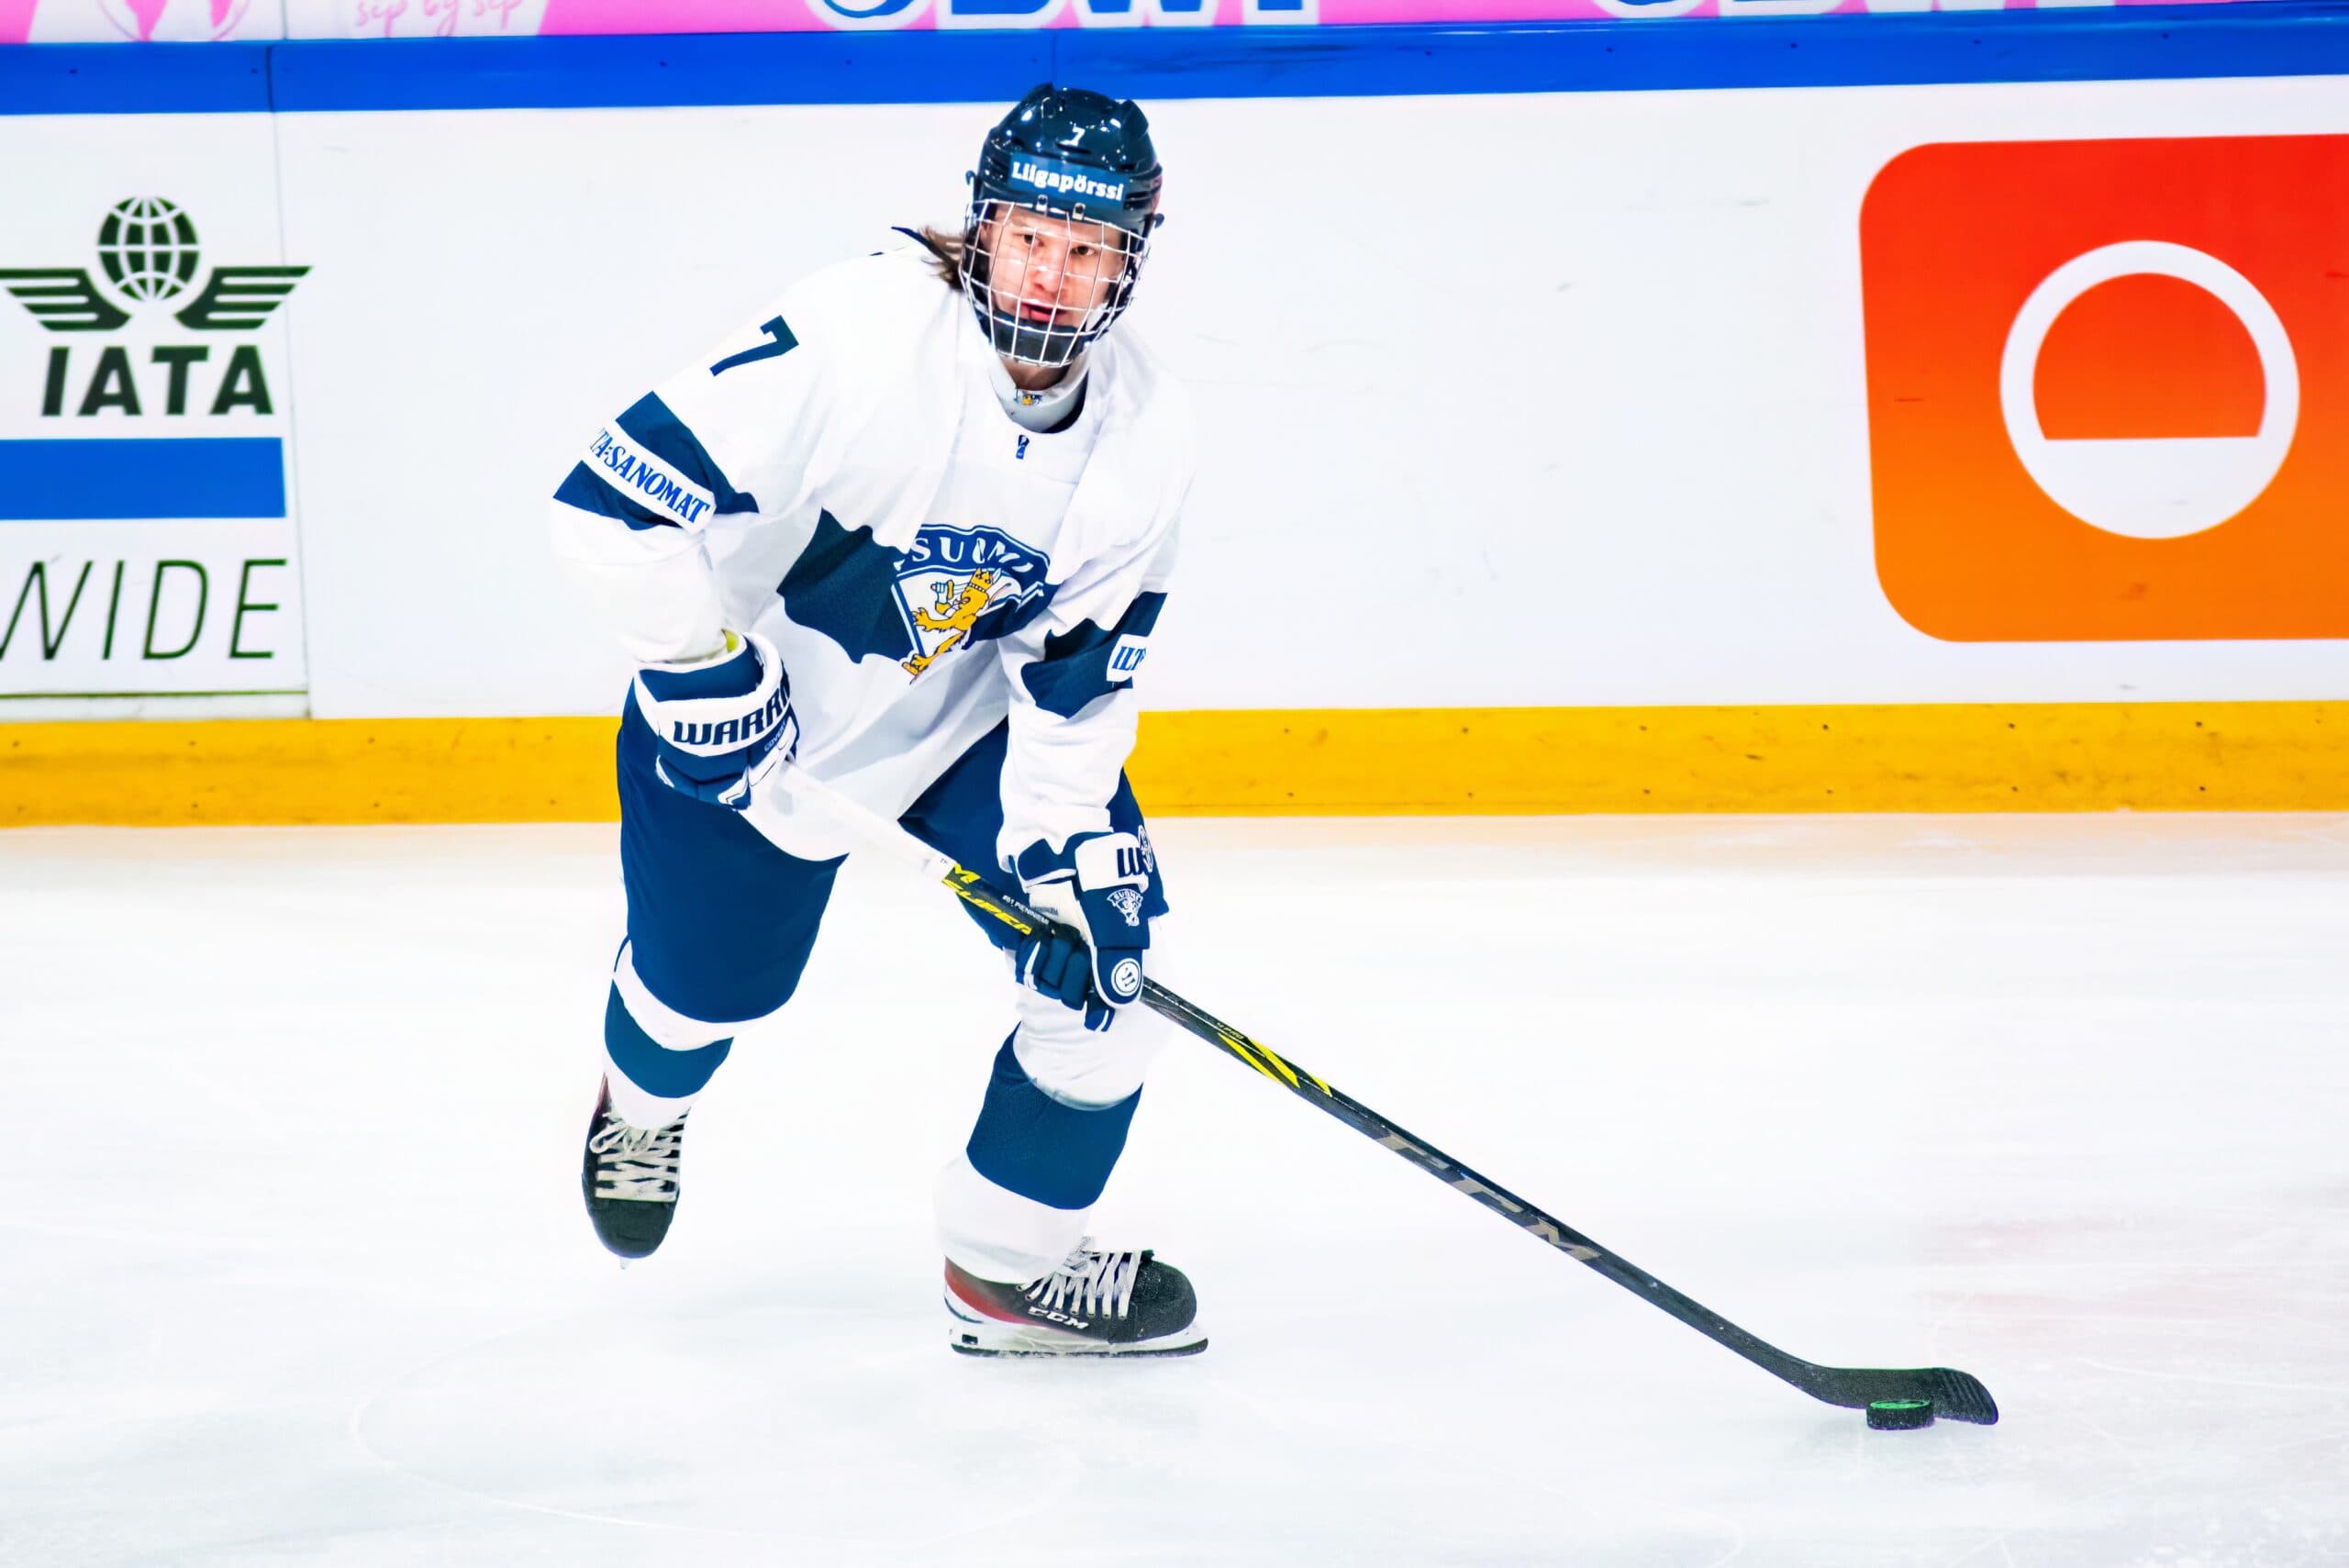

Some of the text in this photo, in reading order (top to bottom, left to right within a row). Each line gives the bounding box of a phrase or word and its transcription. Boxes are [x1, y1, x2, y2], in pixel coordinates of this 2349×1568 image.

[1070, 126, 1085, 147] 7
[1012, 161, 1125, 201] Liigapörssi
[709, 315, 799, 377] 7
[41, 345, 275, 417] IATA
[1028, 1307, 1089, 1329] CCM
